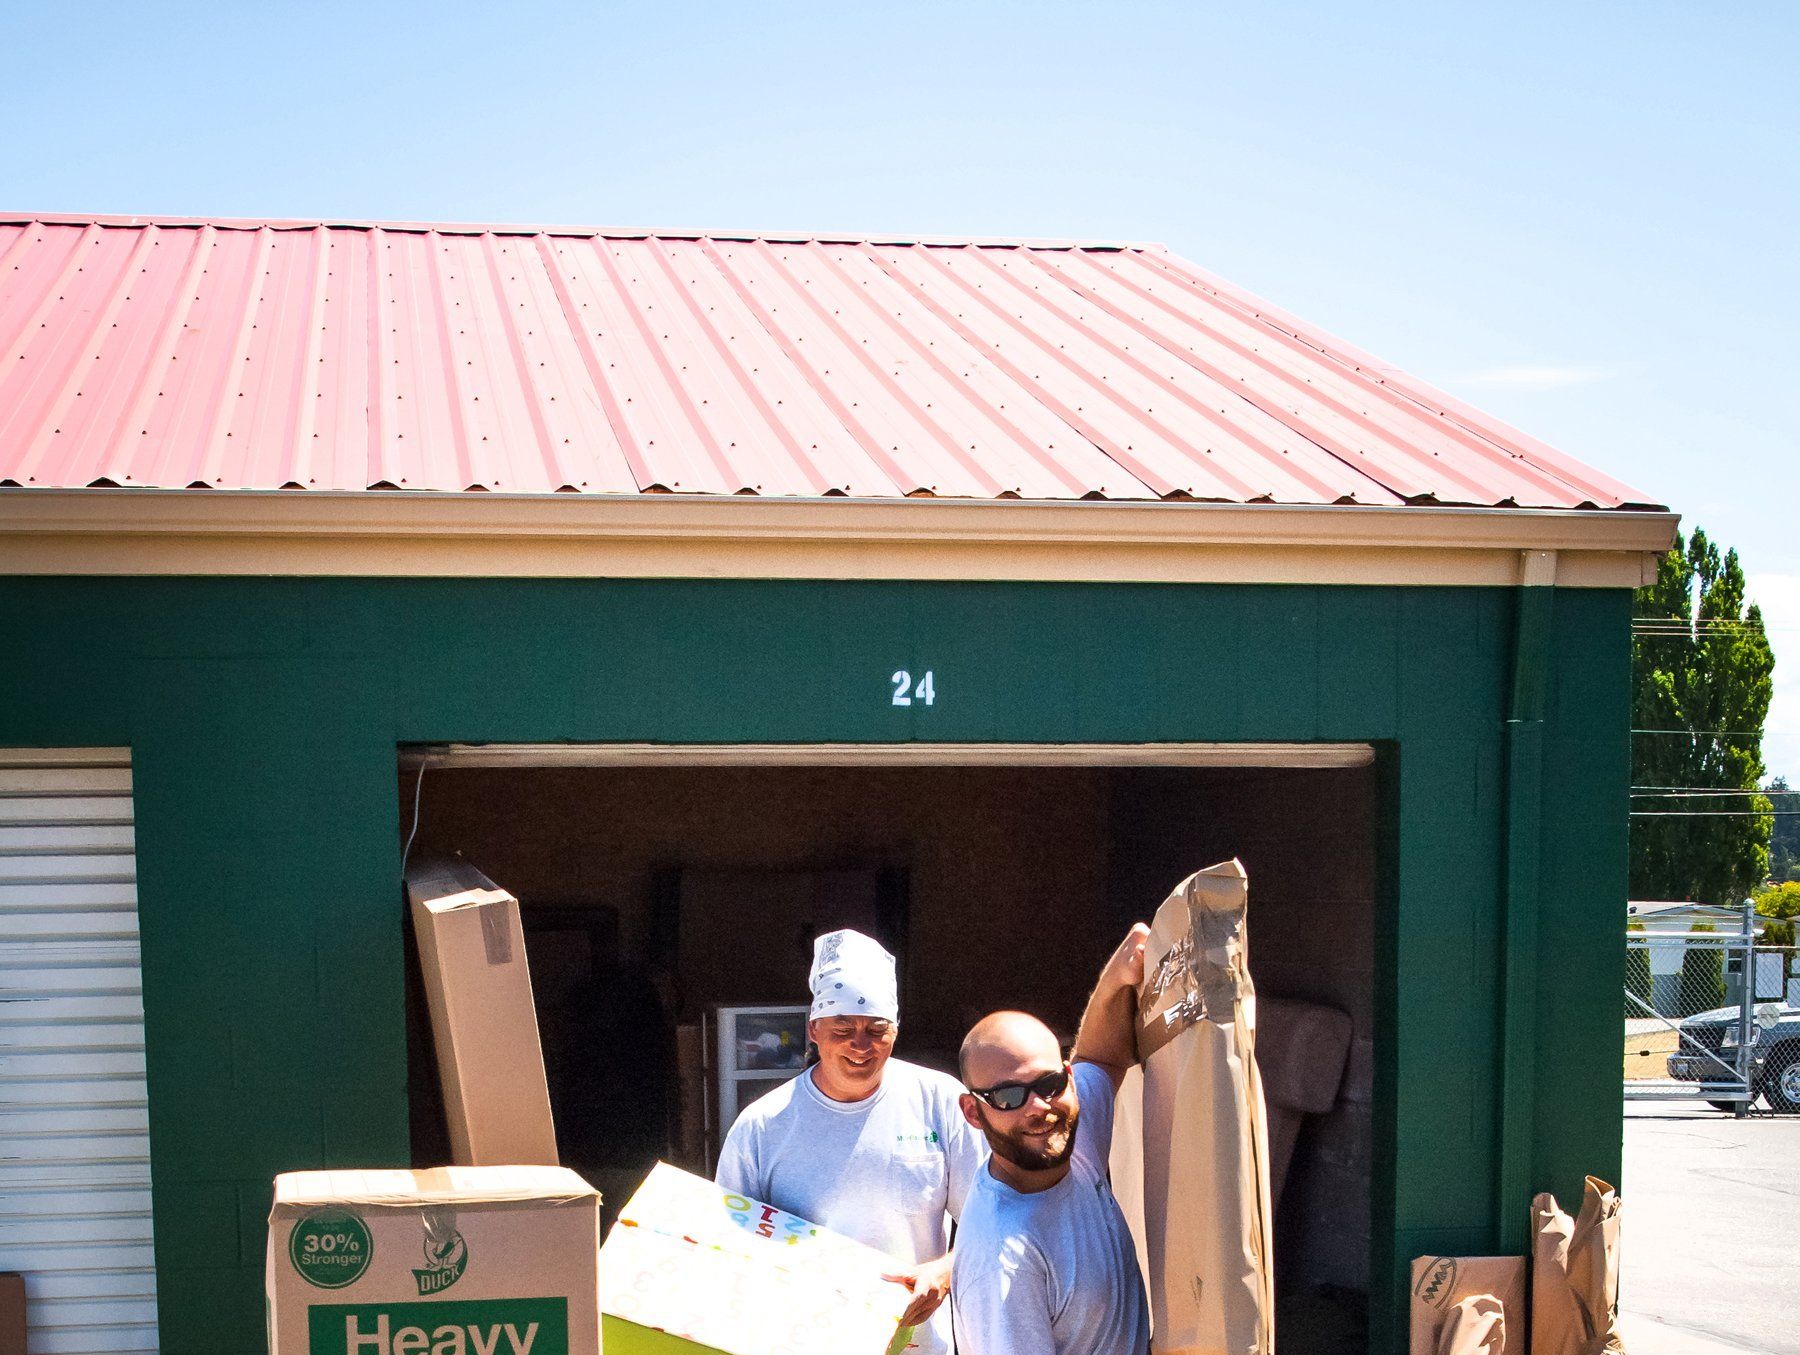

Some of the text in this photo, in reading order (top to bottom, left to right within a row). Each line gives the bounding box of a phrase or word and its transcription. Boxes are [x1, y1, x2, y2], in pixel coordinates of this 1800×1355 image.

[892, 671, 935, 706] 24
[304, 1233, 360, 1253] 30%
[302, 1253, 362, 1267] Stronger
[420, 1265, 459, 1292] DUCK
